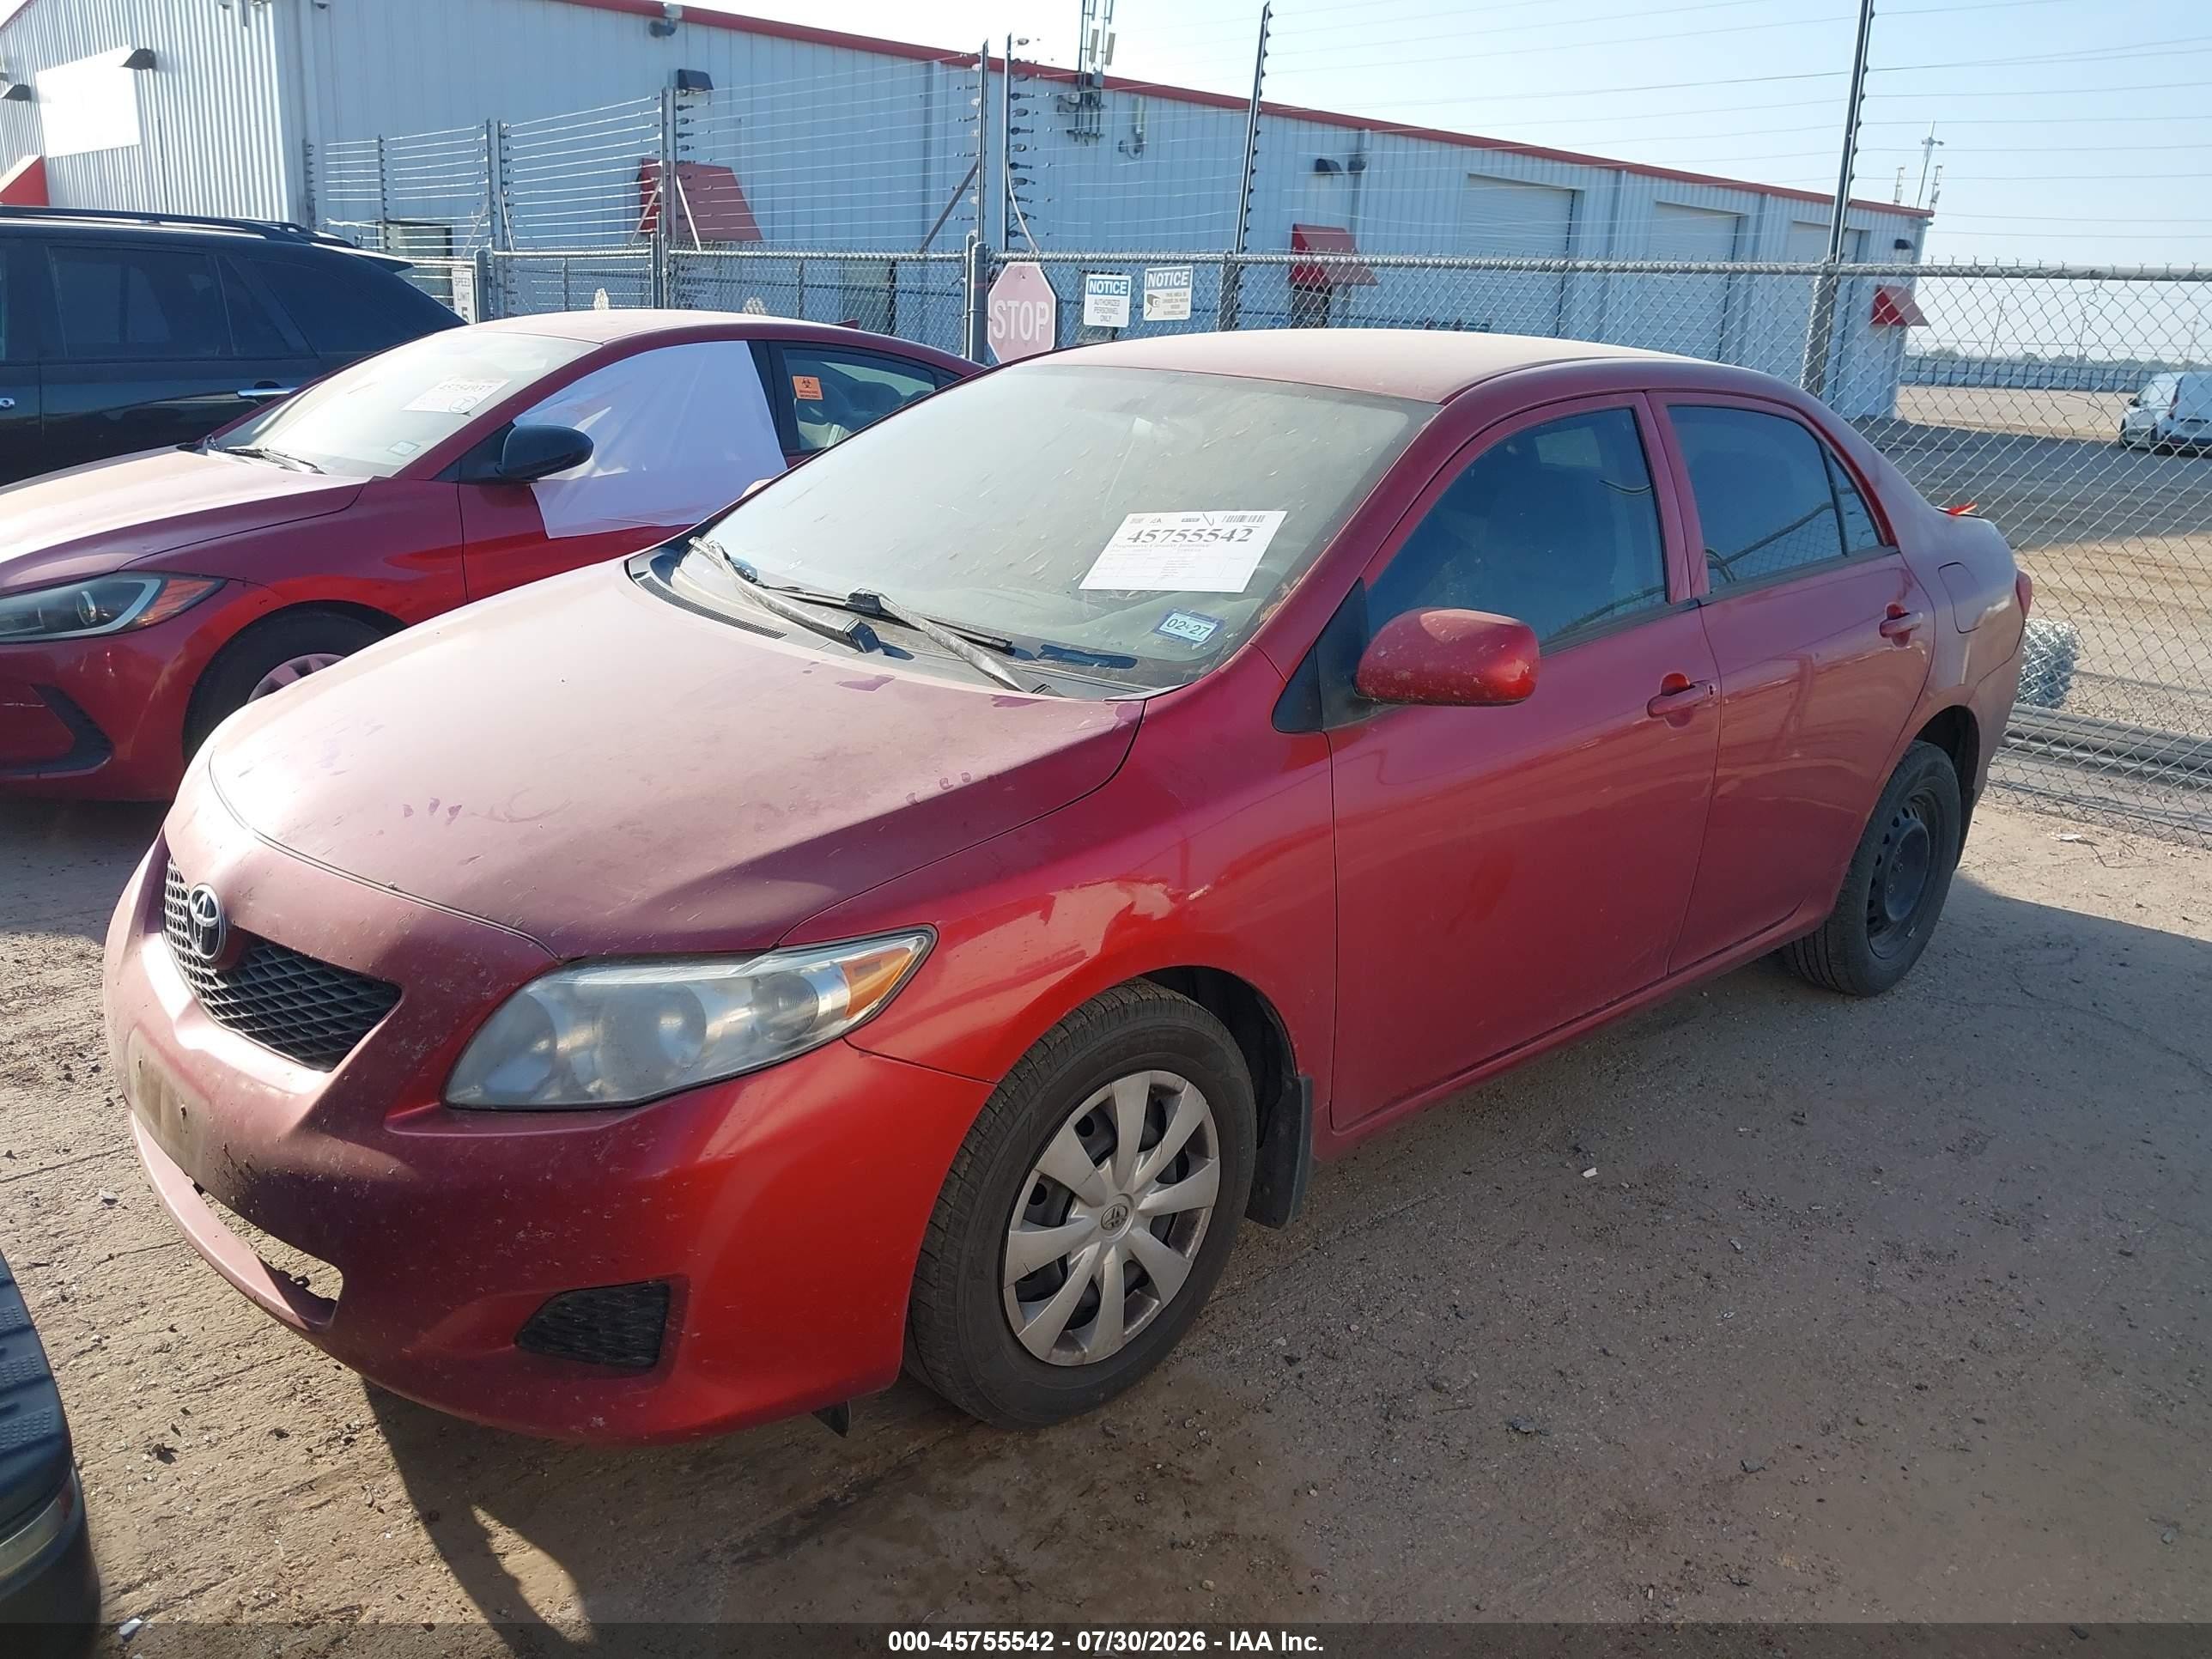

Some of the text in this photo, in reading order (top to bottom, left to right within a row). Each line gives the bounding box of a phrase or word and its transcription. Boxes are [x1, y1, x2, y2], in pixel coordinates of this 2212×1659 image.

[1089, 280, 1127, 295] NOTICE
[1147, 271, 1190, 288] NOTICE
[993, 300, 1049, 343] STOP
[1127, 528, 1254, 543] 45755542
